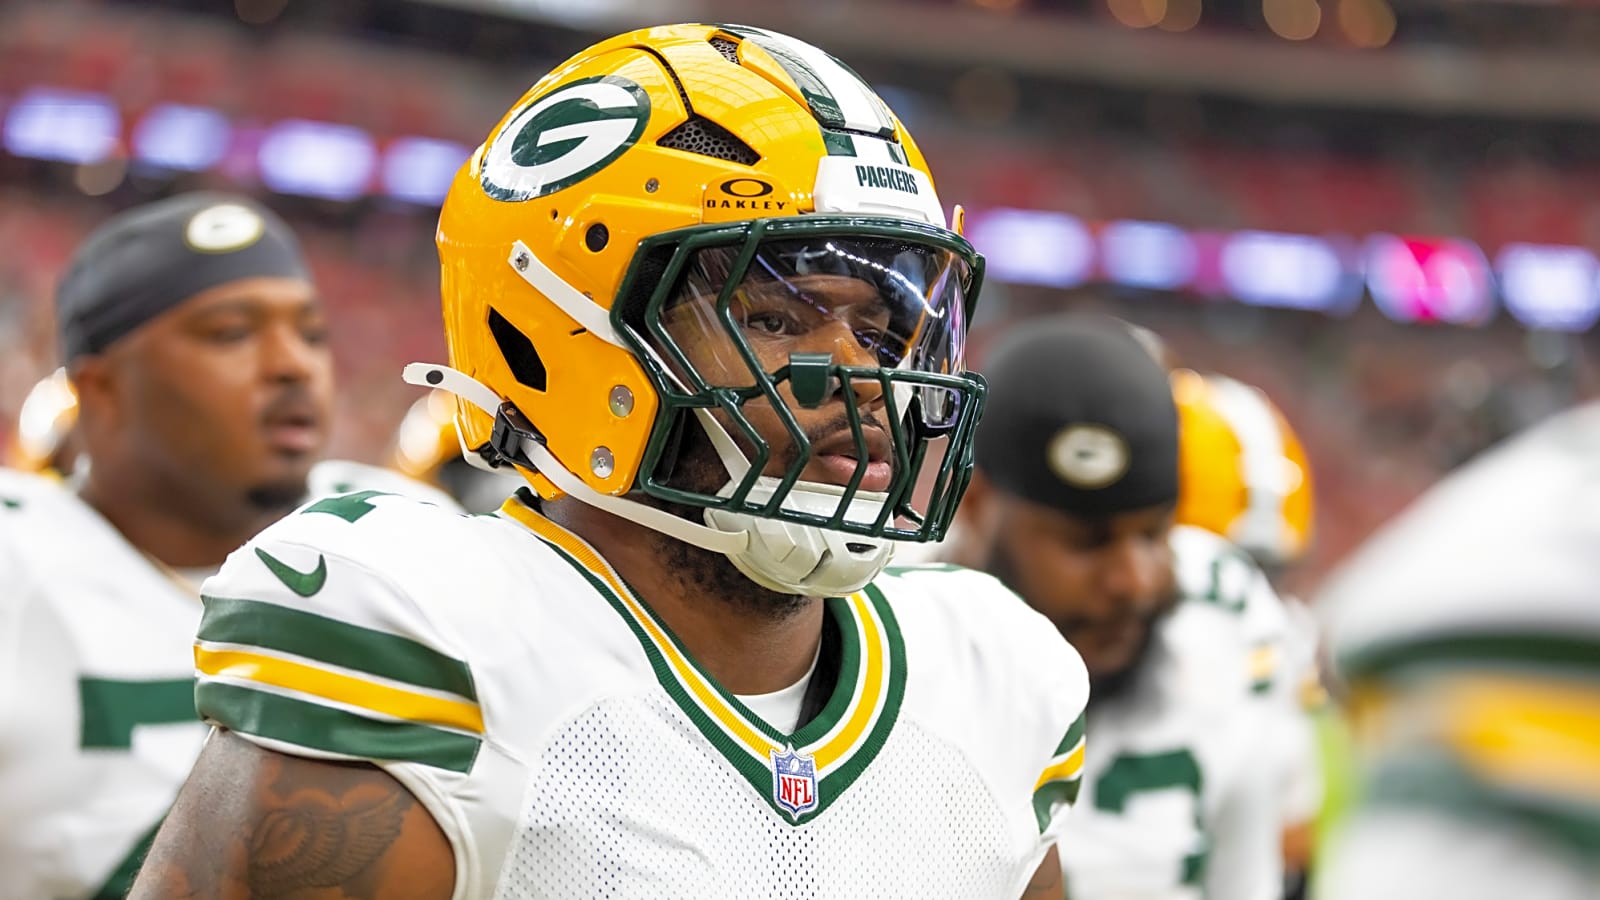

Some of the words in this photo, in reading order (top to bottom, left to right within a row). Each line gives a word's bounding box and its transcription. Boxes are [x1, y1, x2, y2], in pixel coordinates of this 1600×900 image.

[855, 164, 919, 196] PACKERS
[706, 199, 786, 210] OAKLEY
[781, 776, 812, 806] NFL
